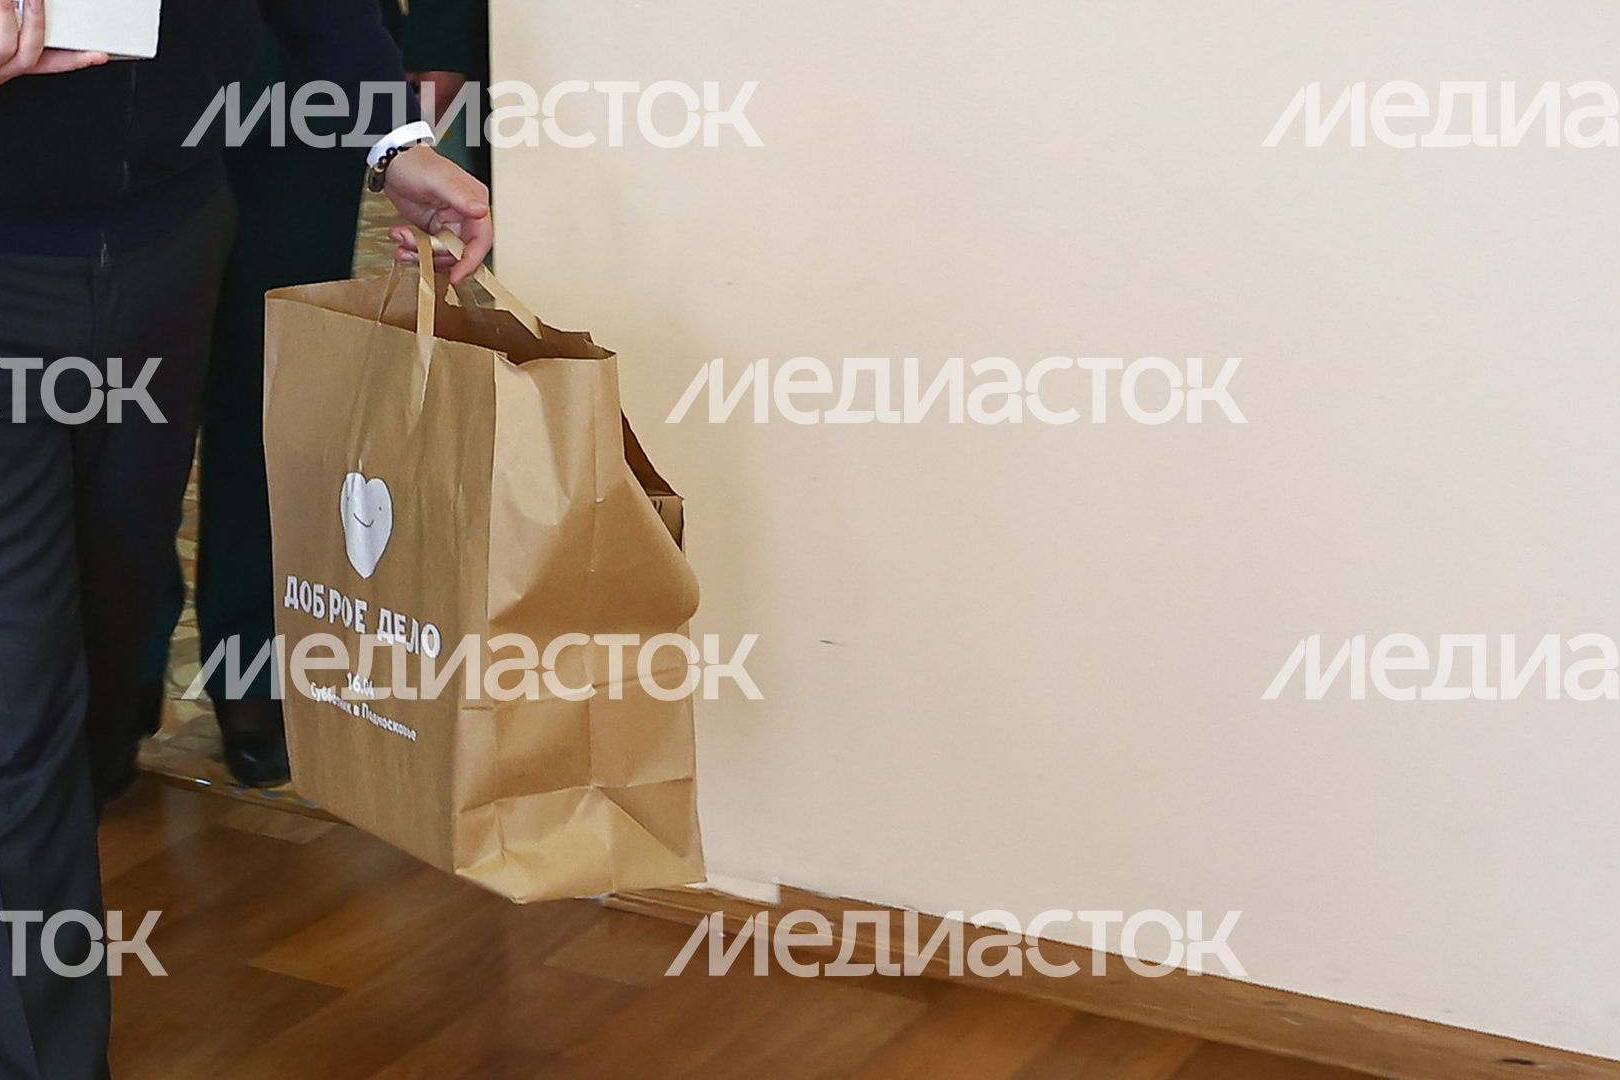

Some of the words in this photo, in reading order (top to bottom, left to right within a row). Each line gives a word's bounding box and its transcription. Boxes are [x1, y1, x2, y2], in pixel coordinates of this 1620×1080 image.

[284, 575, 368, 634] ДОБРОЕ
[376, 607, 442, 659] ДЕЛО
[346, 672, 377, 700] 16.04
